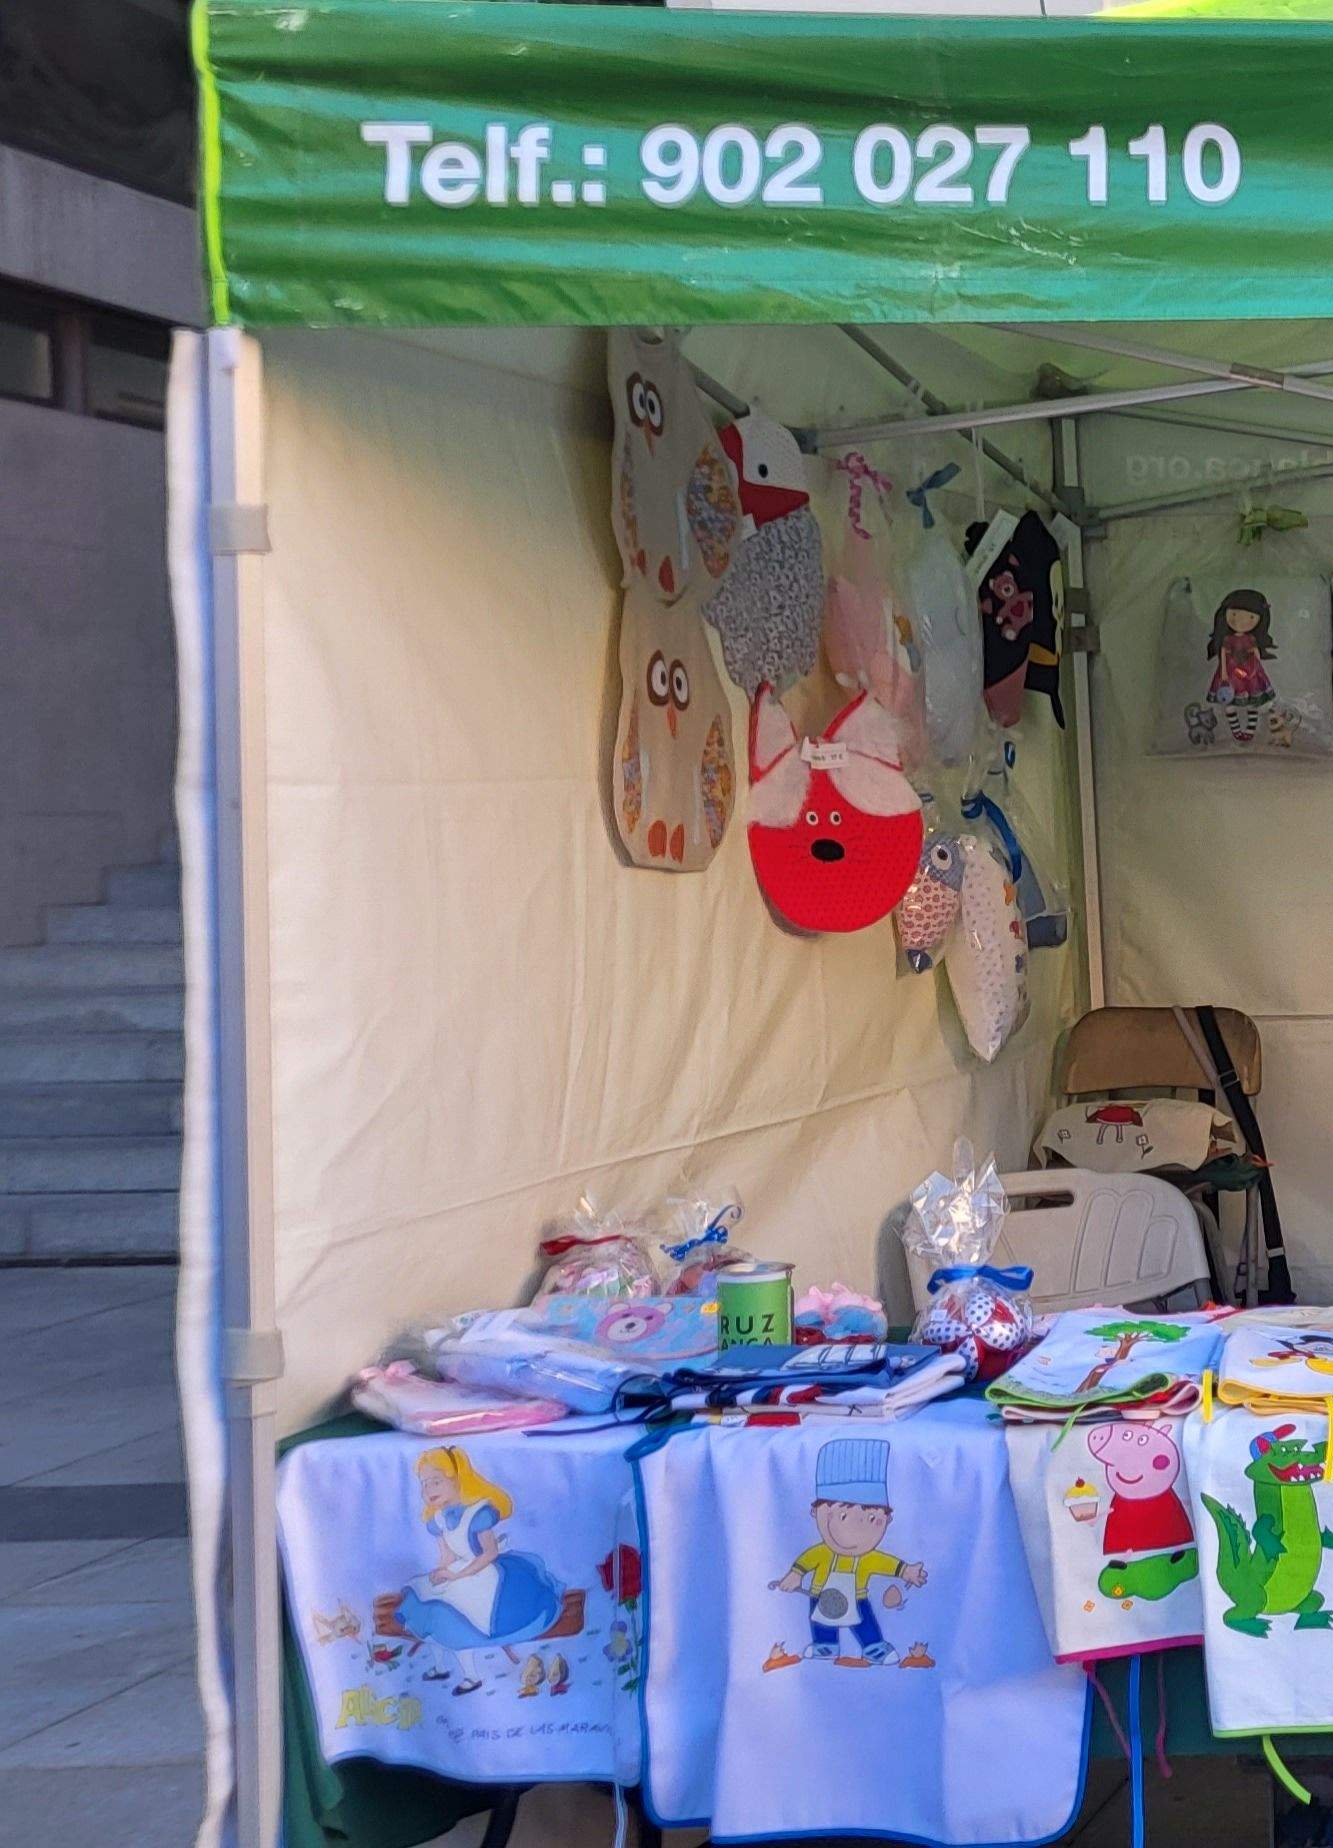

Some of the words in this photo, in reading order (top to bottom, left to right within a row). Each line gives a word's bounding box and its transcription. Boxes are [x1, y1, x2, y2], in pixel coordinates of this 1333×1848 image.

[362, 122, 607, 207] Telf.:
[641, 124, 824, 207] 902
[853, 124, 1031, 207] 027
[1068, 123, 1242, 205] 110
[721, 1314, 775, 1335] RUZ
